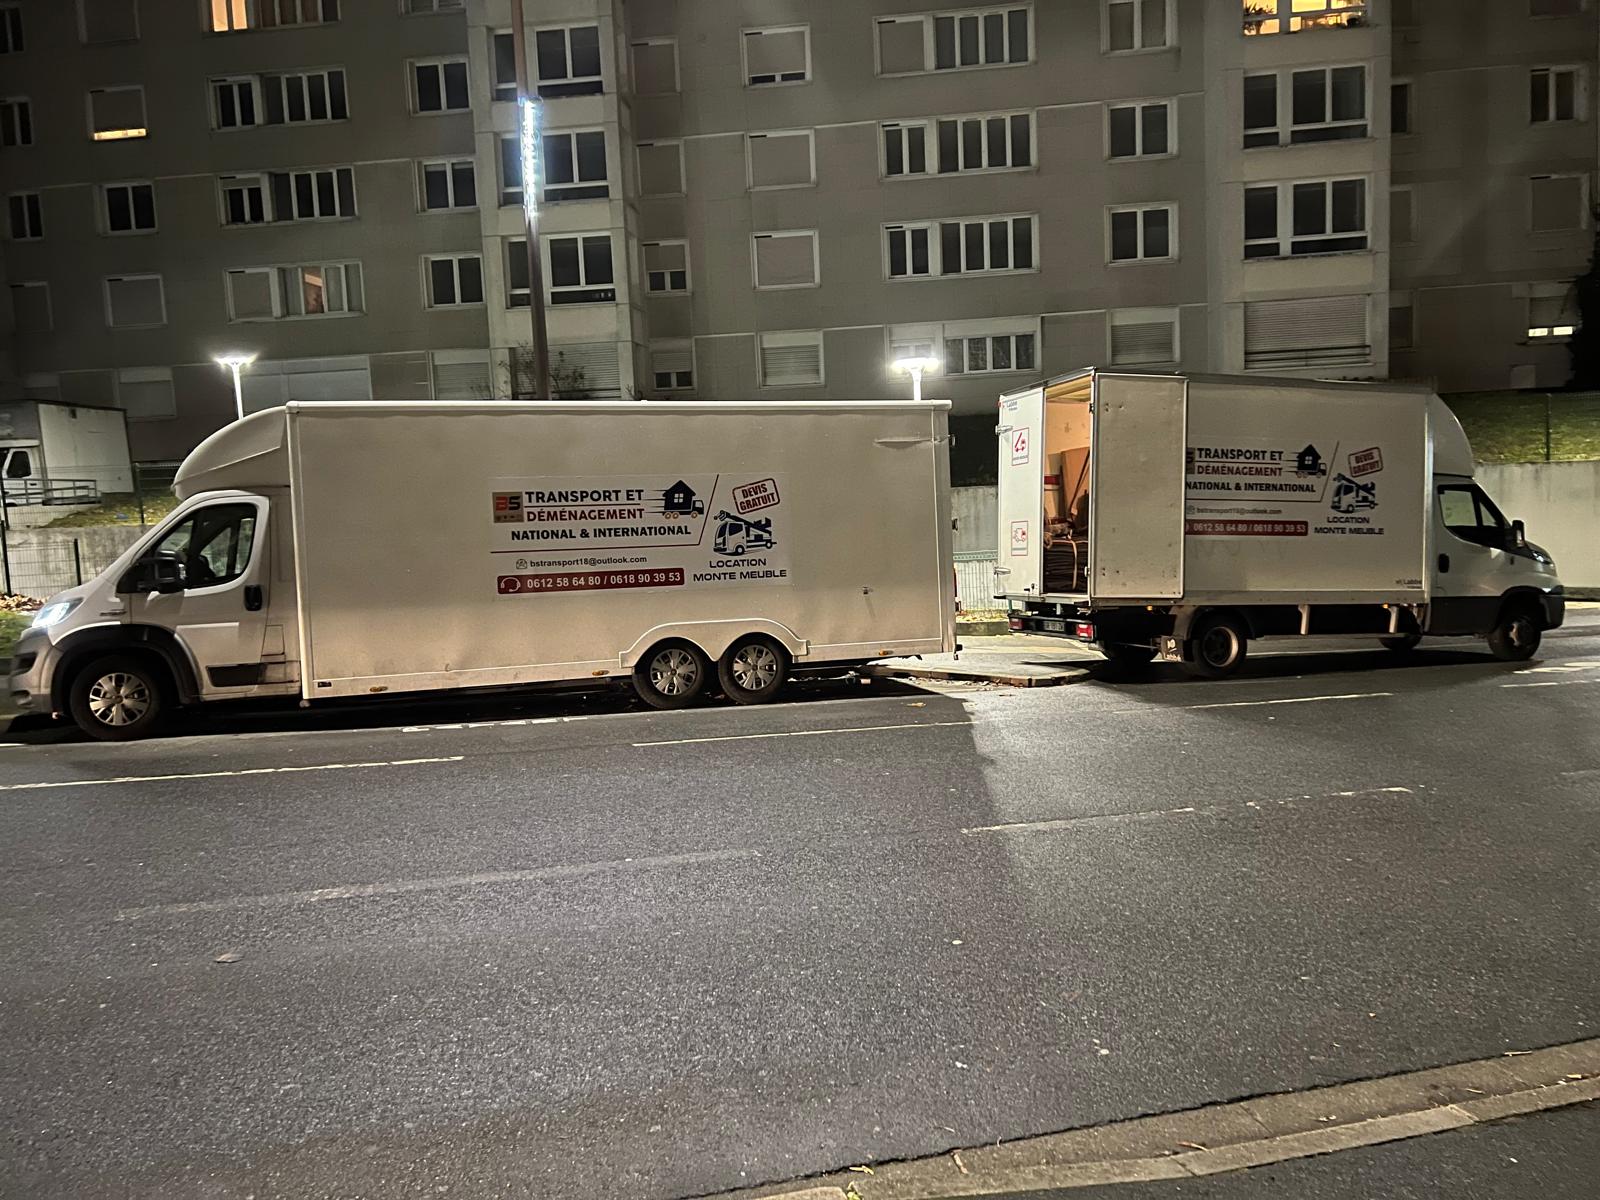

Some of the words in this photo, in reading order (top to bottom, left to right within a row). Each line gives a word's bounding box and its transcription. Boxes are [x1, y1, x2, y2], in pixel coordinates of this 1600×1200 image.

[1197, 448, 1267, 460] TRANSPORT
[1270, 450, 1284, 461] ET
[1197, 464, 1283, 476] DÉMÉNAGEMENT
[741, 483, 768, 499] DEVIS
[1185, 481, 1232, 490] NATIONAL
[1234, 483, 1242, 491] &
[1244, 483, 1316, 493] INTERNATIONAL
[525, 490, 622, 503] TRANSPORT
[626, 489, 644, 501] ET
[739, 492, 776, 512] GRATUIT
[495, 496, 521, 511] BS
[527, 507, 645, 522] DÉMÉNAGEMENT
[1327, 516, 1370, 524] LOCATION
[511, 529, 576, 540] NATIONAL
[580, 528, 590, 538] &
[593, 525, 692, 538] INTERNATIONAL
[530, 556, 647, 568] bstransport18@outlook.com
[709, 558, 767, 569] LOCATION
[527, 578, 553, 589] 0612
[556, 577, 569, 587] 58
[572, 576, 585, 587] 64
[588, 576, 601, 586] 80
[603, 575, 607, 585] /
[610, 574, 635, 585] 0618
[637, 573, 651, 583] 90
[653, 573, 666, 582] 39
[668, 571, 681, 582] 53
[693, 571, 737, 582] MONTE
[744, 569, 787, 579] MEUBLE
